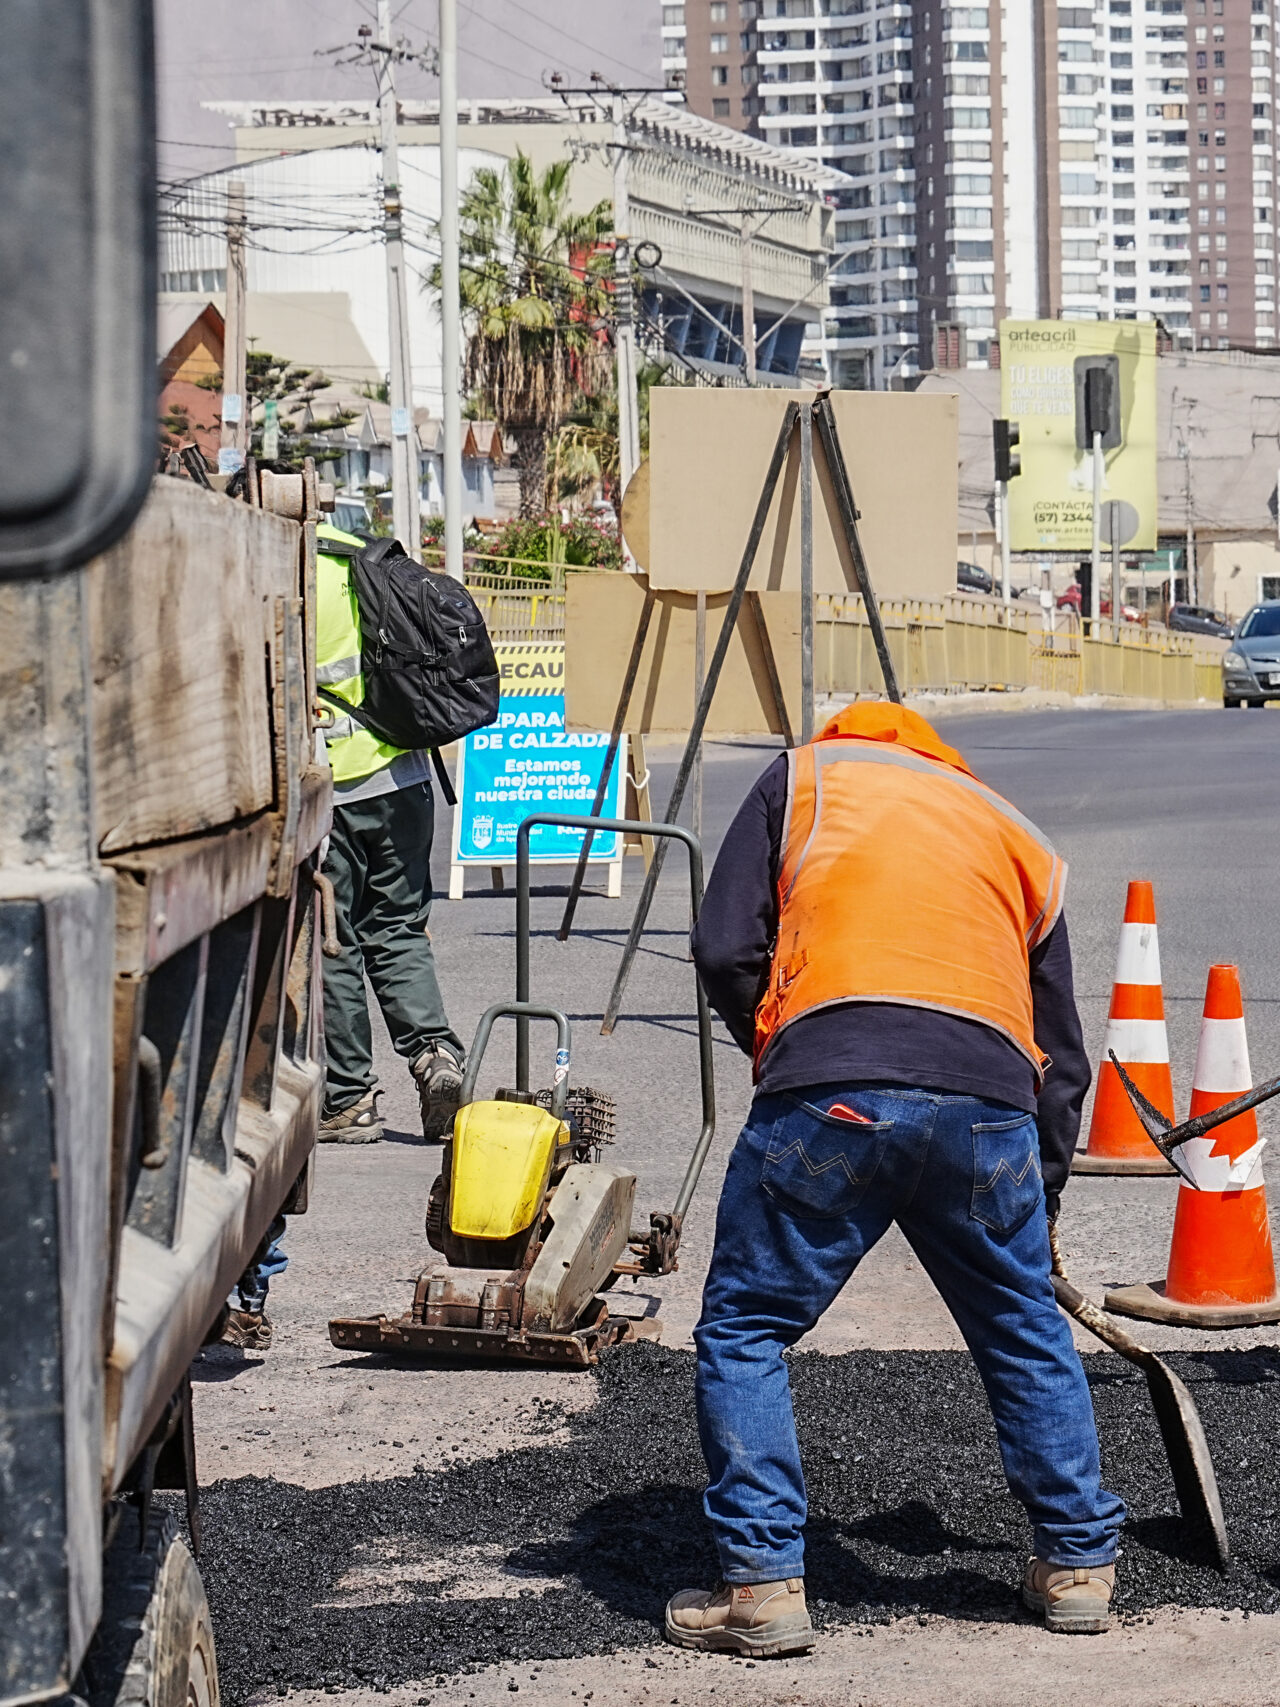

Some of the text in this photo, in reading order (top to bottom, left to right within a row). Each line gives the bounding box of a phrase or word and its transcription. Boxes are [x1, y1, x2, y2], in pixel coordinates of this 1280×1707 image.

[1008, 327, 1076, 342] arteacril
[1009, 341, 1075, 352] PUBLICIDAD
[1029, 366, 1073, 384] ELIGES
[1034, 513, 1058, 524] (57)
[501, 662, 564, 679] ECAU
[473, 732, 612, 750] DE CALZADA
[505, 759, 582, 773] Estamos
[493, 772, 591, 789] mejorando
[474, 787, 543, 802] nuestra
